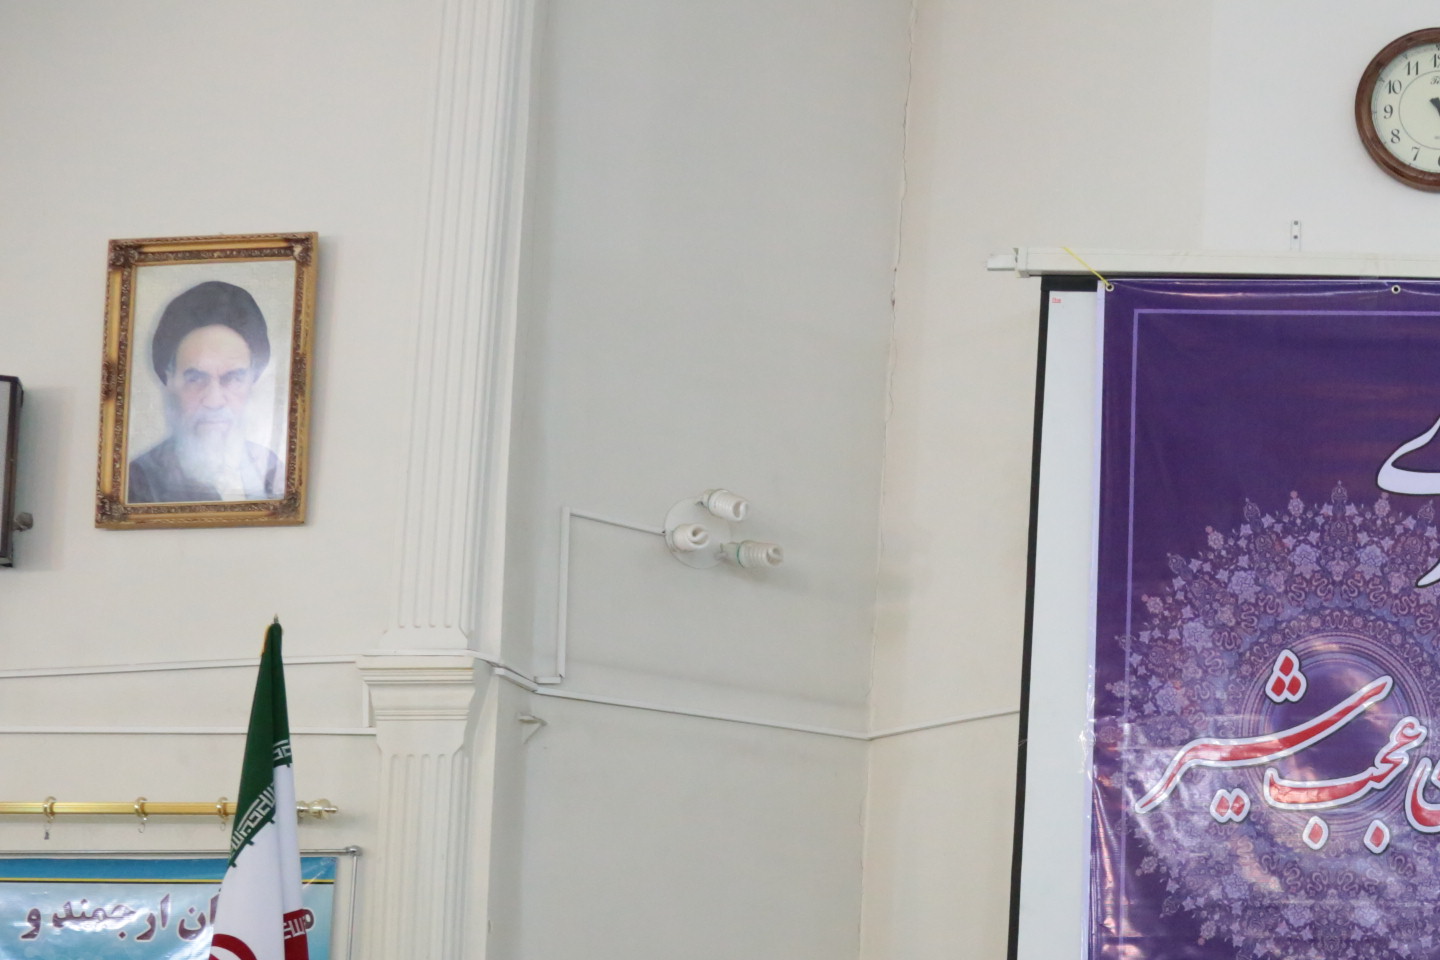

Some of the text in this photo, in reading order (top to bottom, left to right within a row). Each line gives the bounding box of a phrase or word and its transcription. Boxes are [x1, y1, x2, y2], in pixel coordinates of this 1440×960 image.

[1405, 61, 1419, 76] 11
[1387, 79, 1402, 95] 10
[1383, 104, 1394, 120] 9
[1390, 128, 1401, 144] 8
[1411, 147, 1420, 161] 7
[20, 907, 42, 939] و
[52, 893, 171, 941] ارجمند
